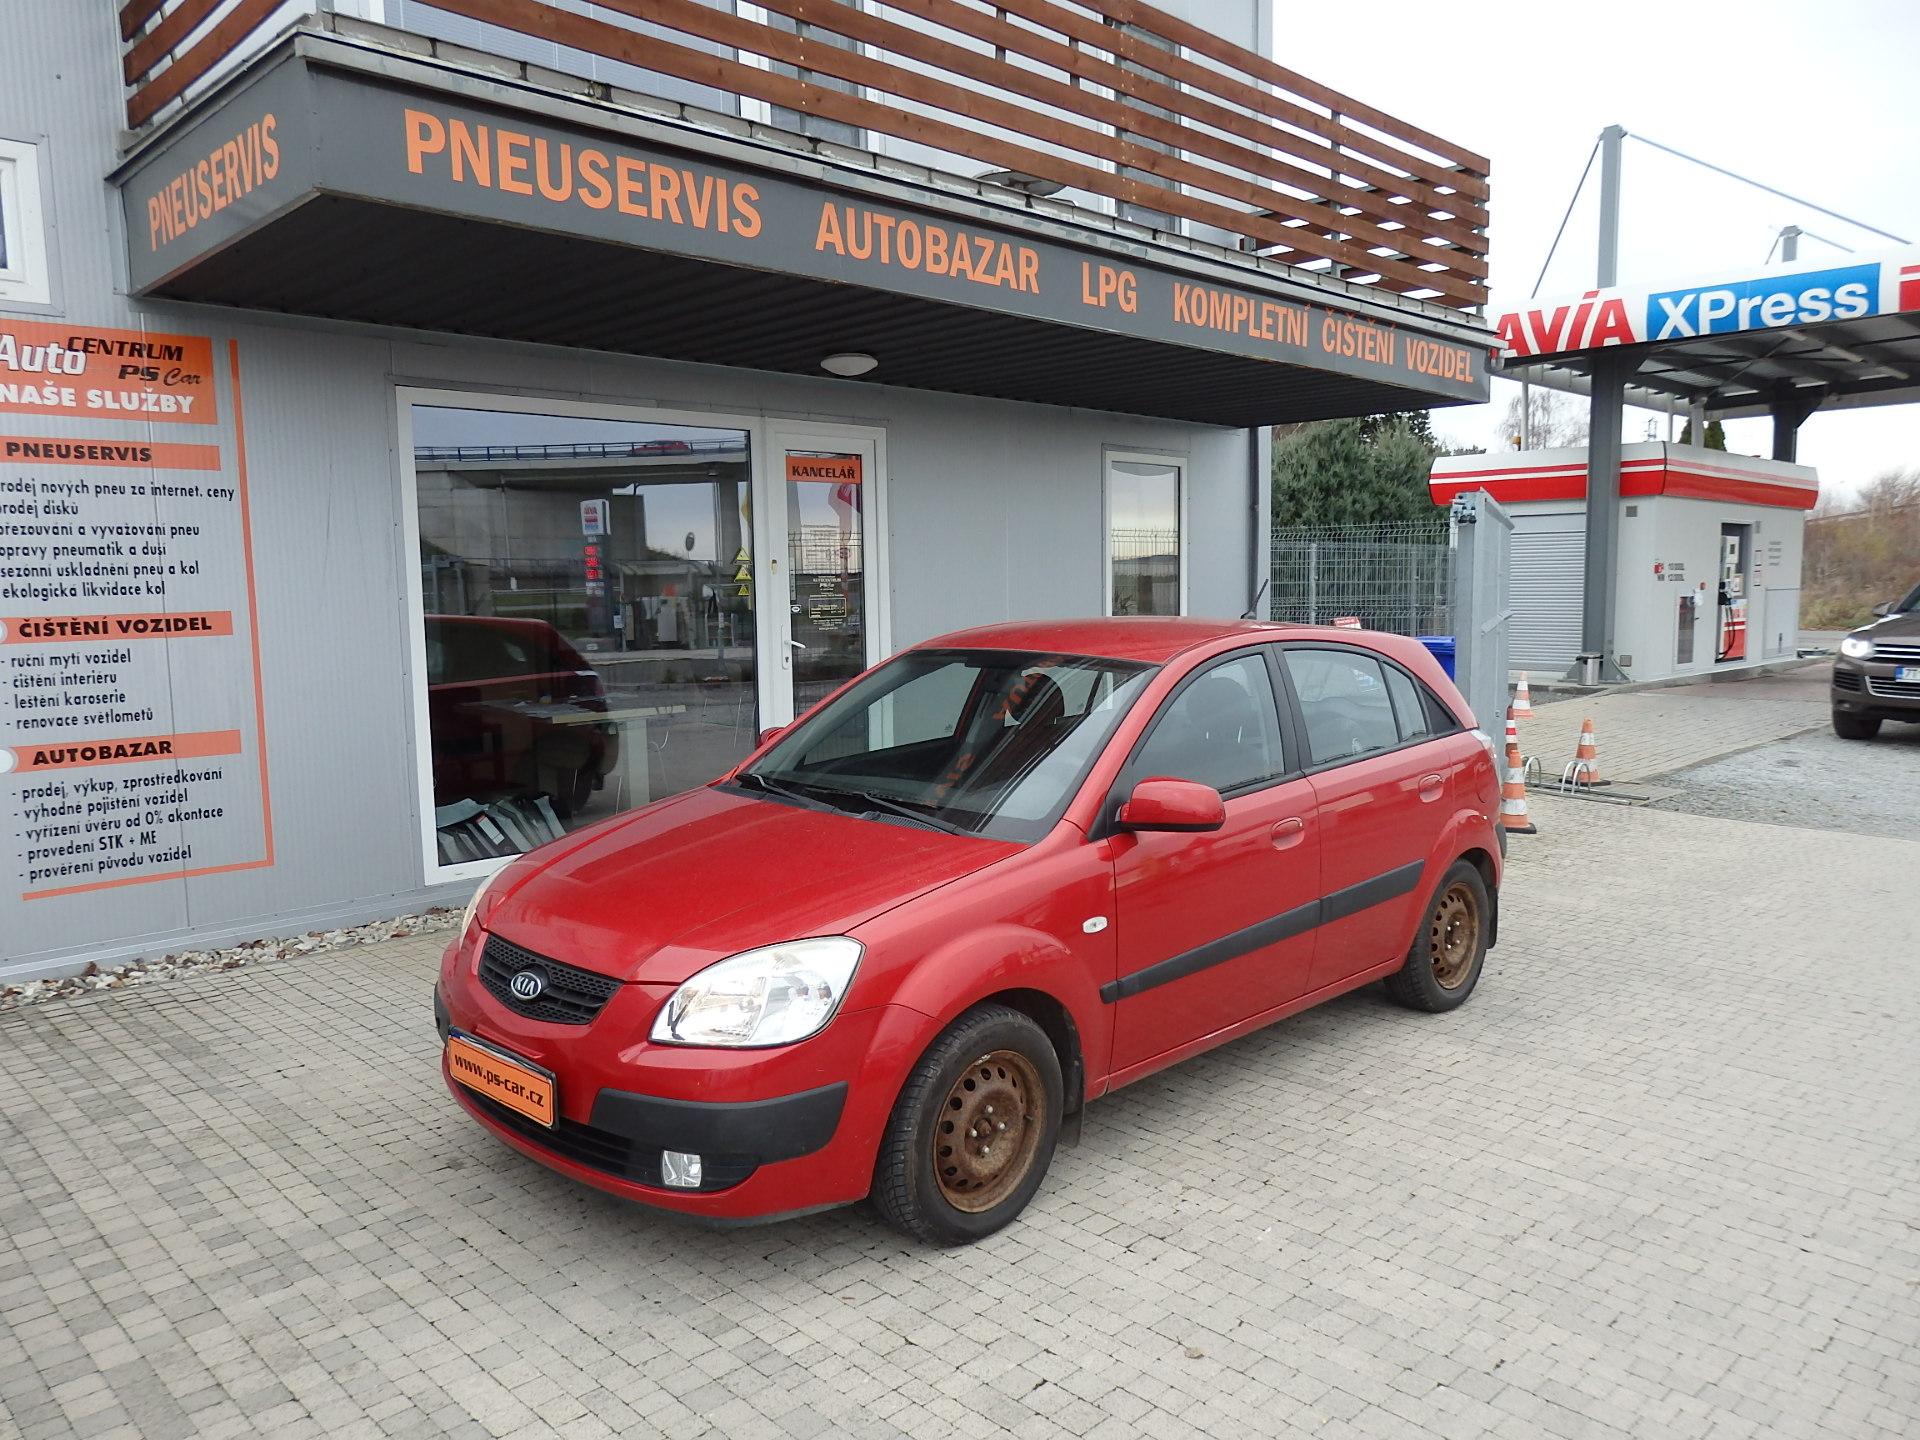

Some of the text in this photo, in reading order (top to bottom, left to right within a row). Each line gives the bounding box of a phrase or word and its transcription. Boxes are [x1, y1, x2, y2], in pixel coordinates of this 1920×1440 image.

[147, 113, 280, 252] PNEUSERVIS
[404, 108, 1474, 384] PNEUSERVIS AUTOBAZAR LPG KOMPLETNÍ ČIŠTĚNÍ VOZIDEL
[1656, 281, 1870, 341] XPress
[0, 333, 185, 375] Auto CENTRUM
[118, 364, 203, 386] PS Car
[0, 379, 194, 414] NAŠE SLUŽBY
[6, 441, 152, 462] PNEUSERVIS
[792, 465, 856, 479] KANCELÁŘ
[0, 478, 234, 501] rodej nových pneu za internet. ceny
[43, 500, 79, 515] disků
[78, 525, 86, 536] a
[91, 523, 166, 540] vyvažování
[170, 526, 200, 539] pneu
[0, 546, 47, 560] opravy
[53, 541, 124, 560] pneumatik
[129, 546, 137, 556] a
[57, 561, 129, 577] uskladnění
[133, 564, 164, 579] pneu
[168, 565, 176, 575] a
[180, 560, 200, 575] kol
[3, 580, 165, 601] ekologická likvidace kol
[19, 616, 212, 638] ČIŠTĚNÍ VOZIDEL
[11, 653, 45, 668] ruční
[85, 648, 131, 665] vozidel
[13, 669, 117, 689] čištění interiéru
[14, 688, 126, 709] leštění karoserie
[16, 707, 153, 730] renovace světlometů
[33, 740, 172, 765] AUTOBAZAR
[123, 767, 222, 792] zprostředkování
[24, 788, 188, 822] výhodné pojištění vozidel
[26, 807, 223, 843] vyřízení úvěru od 0% akontace
[28, 839, 95, 863] provedení
[99, 834, 124, 851] STK
[140, 830, 157, 845] ME
[29, 845, 192, 884] prověření původu vozidel
[514, 975, 536, 996] KIA
[454, 1055, 544, 1107] www.ps-car.cz
